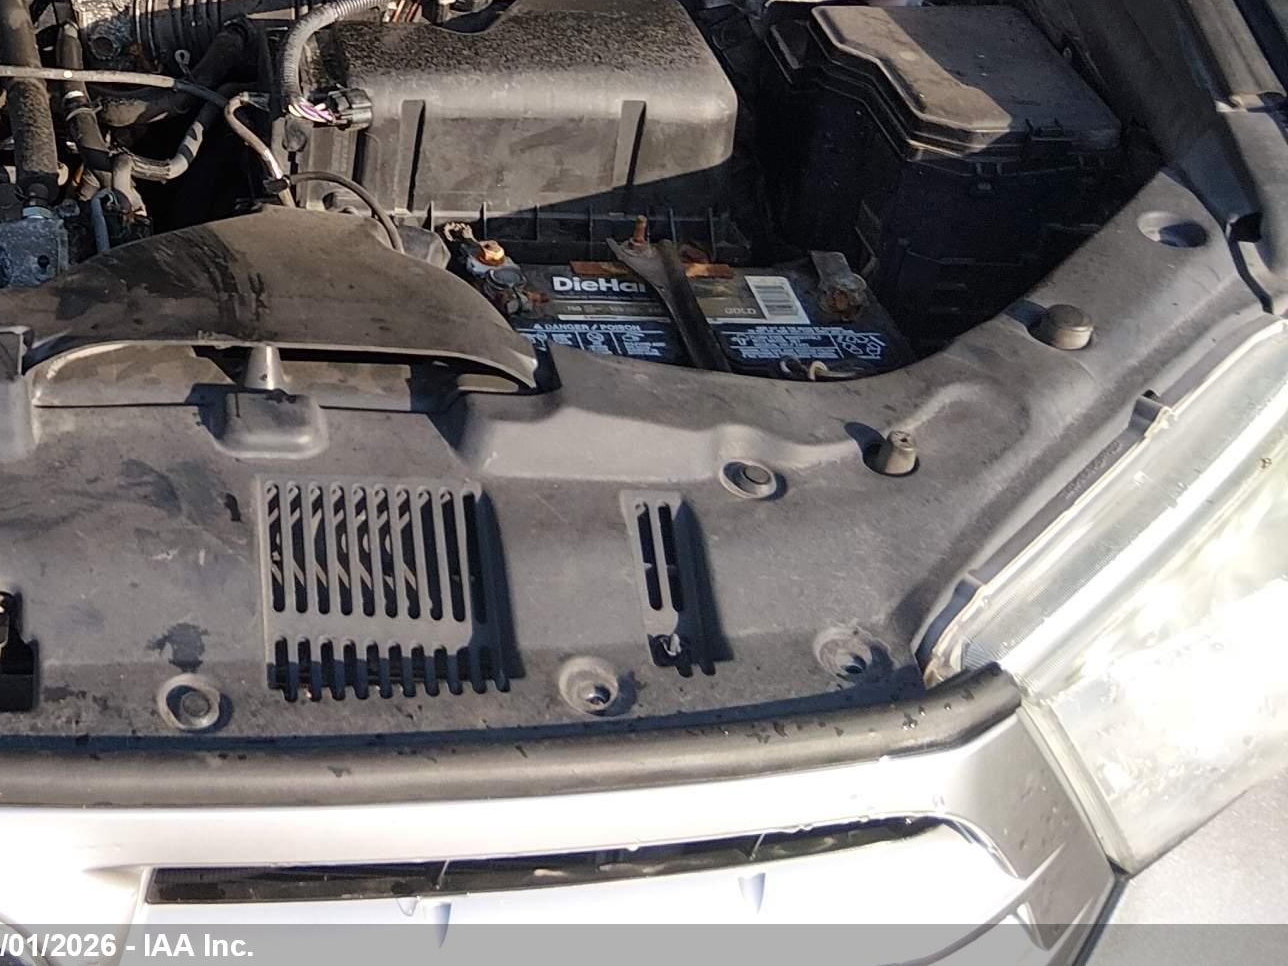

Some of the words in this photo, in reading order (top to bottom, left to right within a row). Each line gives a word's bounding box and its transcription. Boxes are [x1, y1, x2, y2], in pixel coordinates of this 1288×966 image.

[552, 276, 648, 293] DieHar
[725, 306, 757, 315] GOLD
[544, 323, 589, 331] DANGER
[599, 324, 641, 332] POISON
